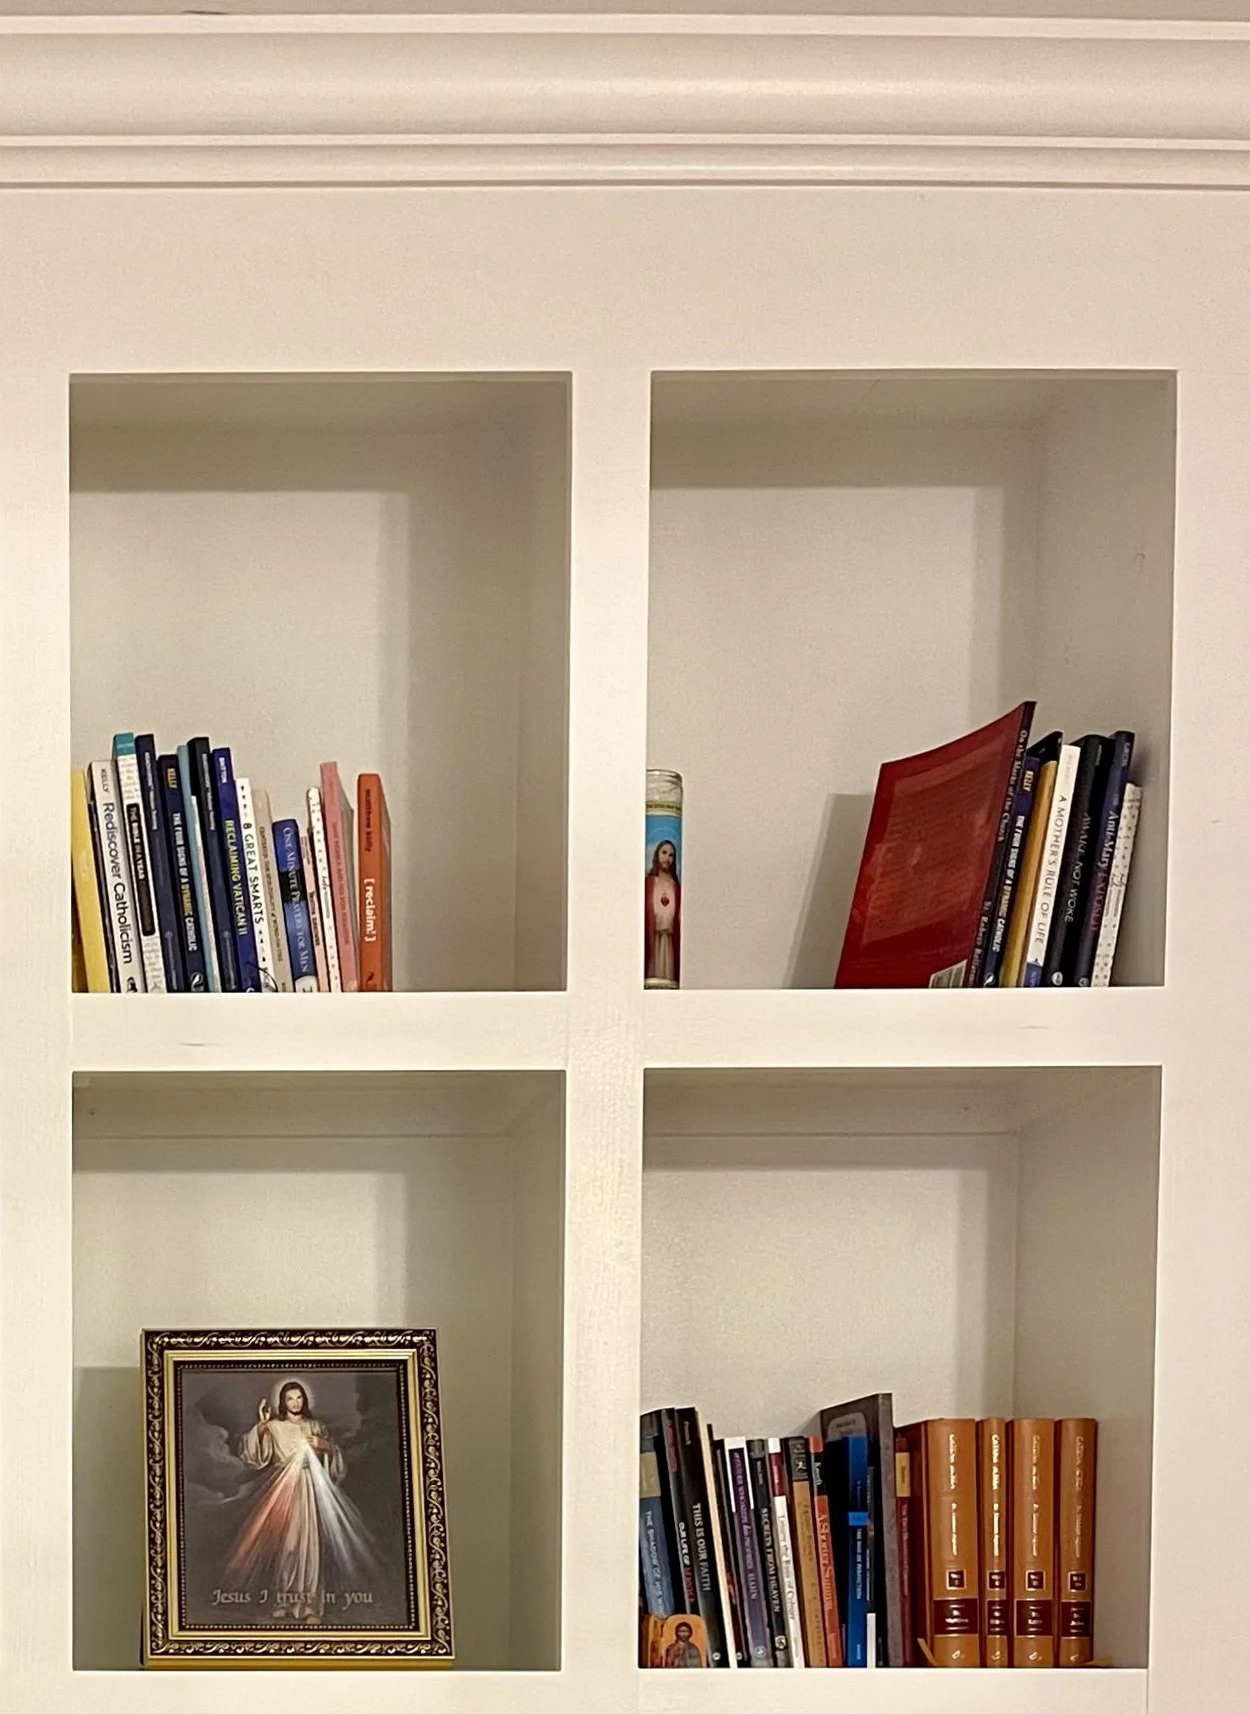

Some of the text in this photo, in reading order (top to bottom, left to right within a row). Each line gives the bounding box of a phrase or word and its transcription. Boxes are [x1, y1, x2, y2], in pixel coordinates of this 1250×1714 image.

[100, 768, 110, 793] KELLY
[1023, 770, 1034, 792] KELLY
[1058, 795, 1067, 803] A
[1015, 815, 1025, 827] THE
[1012, 828, 1023, 847] FOUR
[1048, 806, 1066, 866] MOTHER'S
[1098, 810, 1118, 869] Anti-Mary
[1008, 848, 1020, 868] SIGNS
[103, 802, 134, 964] Rediscover Catholicism
[224, 819, 247, 935] RECLAIMING VATICAN II
[243, 822, 264, 924] 8 GREAT SMARTS
[1042, 869, 1055, 897] RULE
[1072, 861, 1083, 886] NOT
[1038, 902, 1050, 919] OF
[1064, 890, 1078, 923] WOKE
[185, 917, 197, 951] CATHOLIC
[992, 918, 1006, 952] CATHOLIC
[1034, 922, 1046, 944] LIFE
[692, 1502, 710, 1591] THIS IS OUR FAITH
[211, 1588, 373, 1610] Jesus I trust in you
